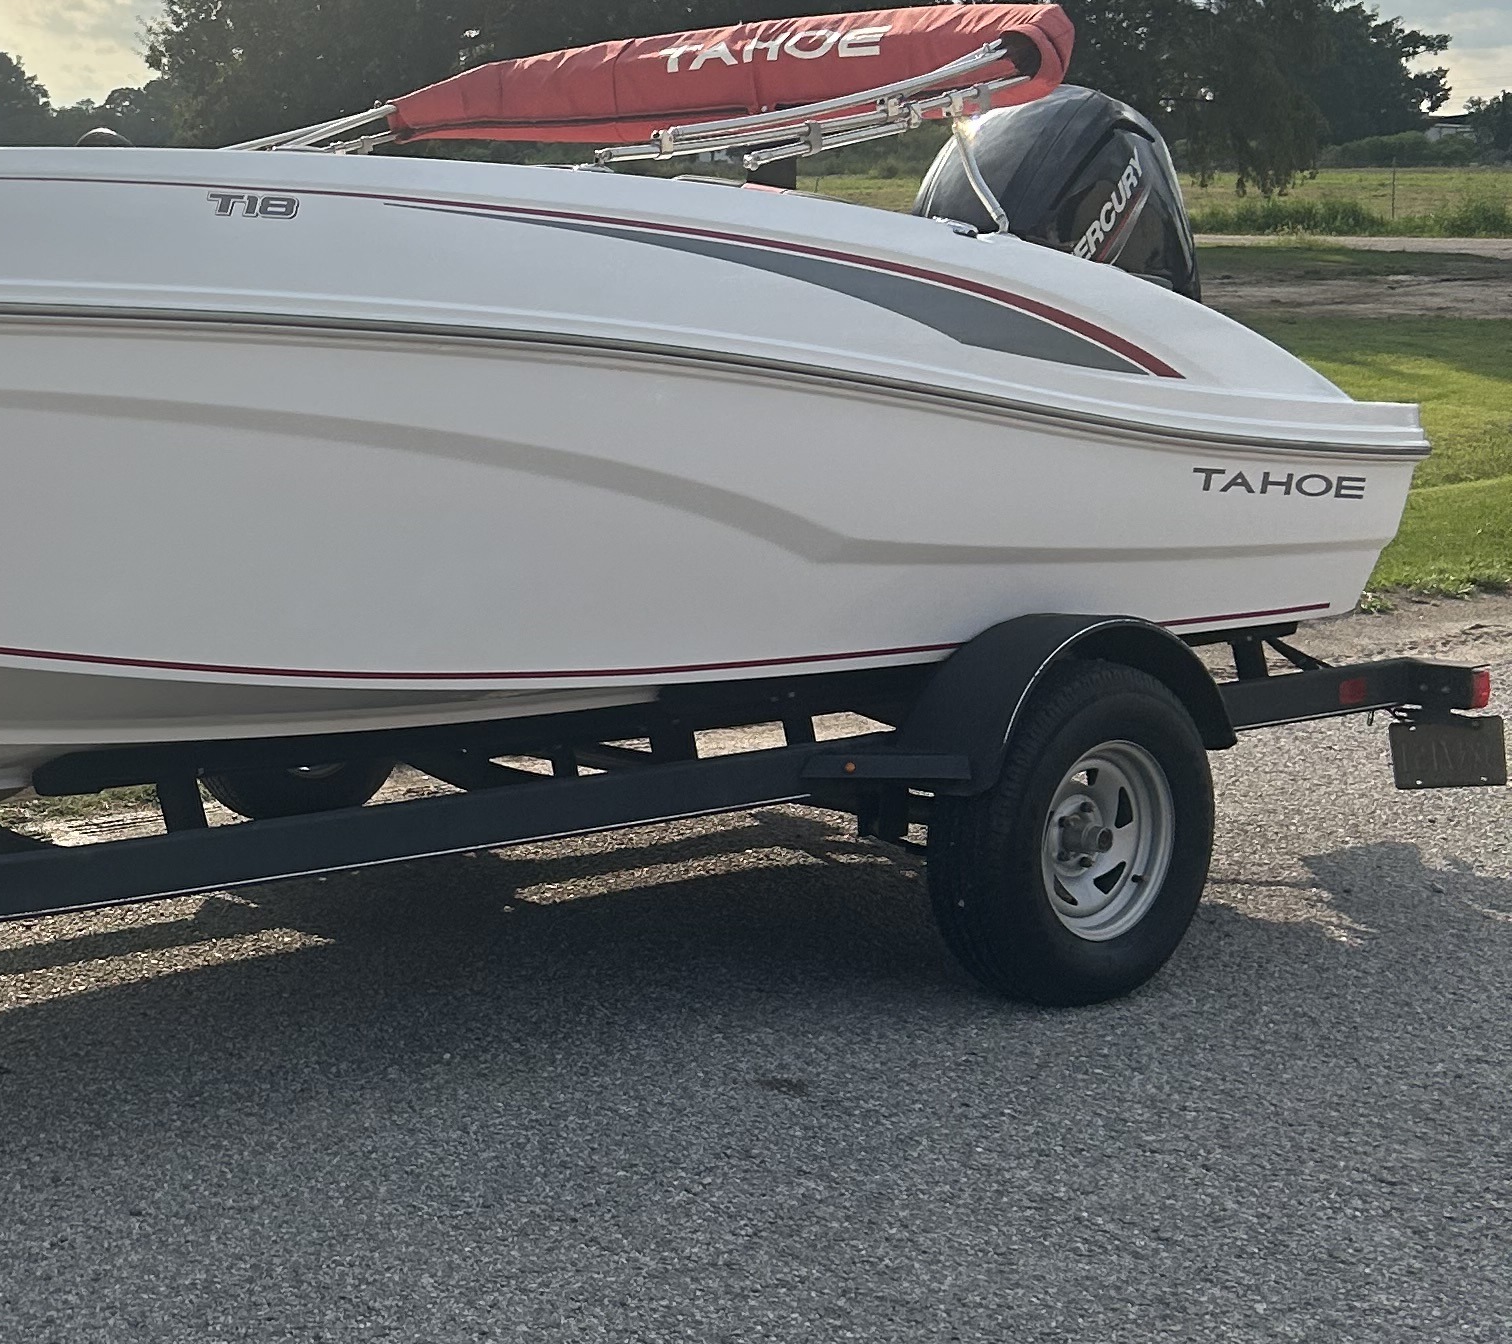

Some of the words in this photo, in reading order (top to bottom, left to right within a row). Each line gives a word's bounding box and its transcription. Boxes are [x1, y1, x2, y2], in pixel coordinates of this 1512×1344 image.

[659, 24, 892, 73] TAHOE
[207, 191, 299, 219] T18
[1071, 146, 1143, 260] ERCURY
[1193, 467, 1366, 499] TAHOE
